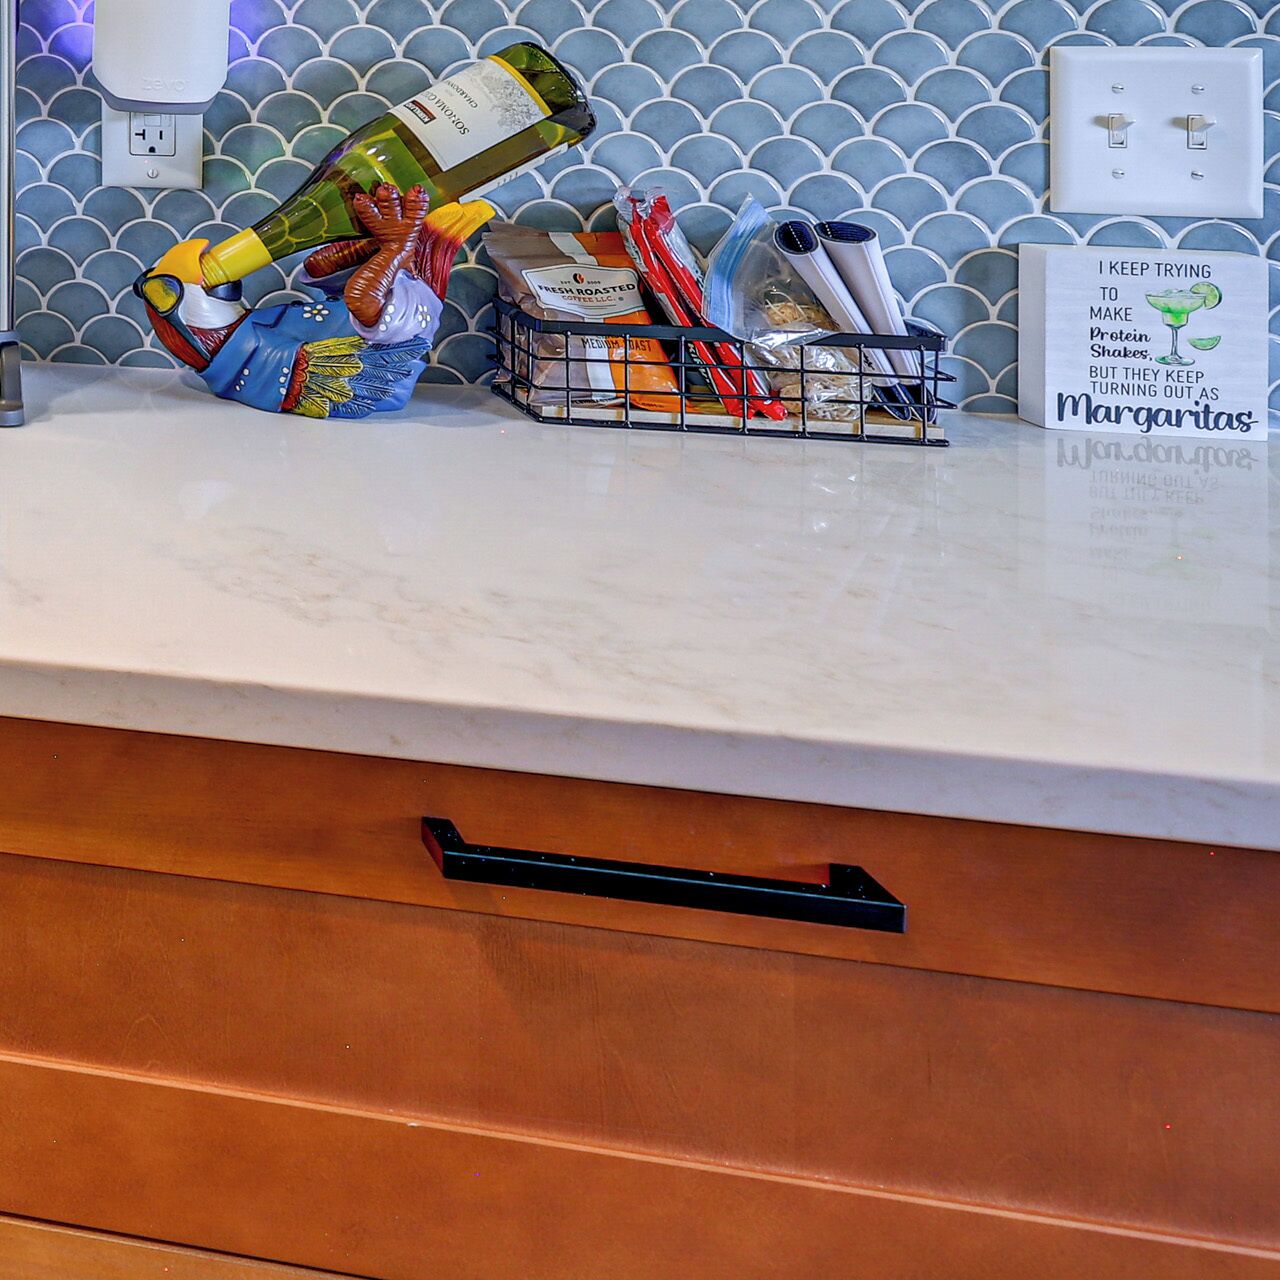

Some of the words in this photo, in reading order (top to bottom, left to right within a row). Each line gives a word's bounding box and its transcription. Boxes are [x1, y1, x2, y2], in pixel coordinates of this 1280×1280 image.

[434, 97, 470, 136] SONOMA
[1098, 260, 1103, 274] I
[1109, 261, 1150, 277] KEEP
[1154, 262, 1212, 279] TRYING
[538, 284, 574, 296] FRESH
[576, 283, 636, 296] ROASTED
[1099, 286, 1118, 301] TO
[561, 295, 594, 303] COFFEE
[1090, 306, 1133, 322] MAKE
[1089, 326, 1151, 343] Protein
[627, 338, 652, 352] OAST
[1090, 343, 1153, 362] Shakes,
[1090, 365, 1118, 380] BUT
[1123, 367, 1160, 382] THEY
[1166, 370, 1204, 384] KEEP
[1090, 381, 1158, 397] TURNING
[1164, 384, 1194, 400] OUT
[1199, 387, 1219, 401] AS
[1057, 391, 1259, 433] Margaritas
